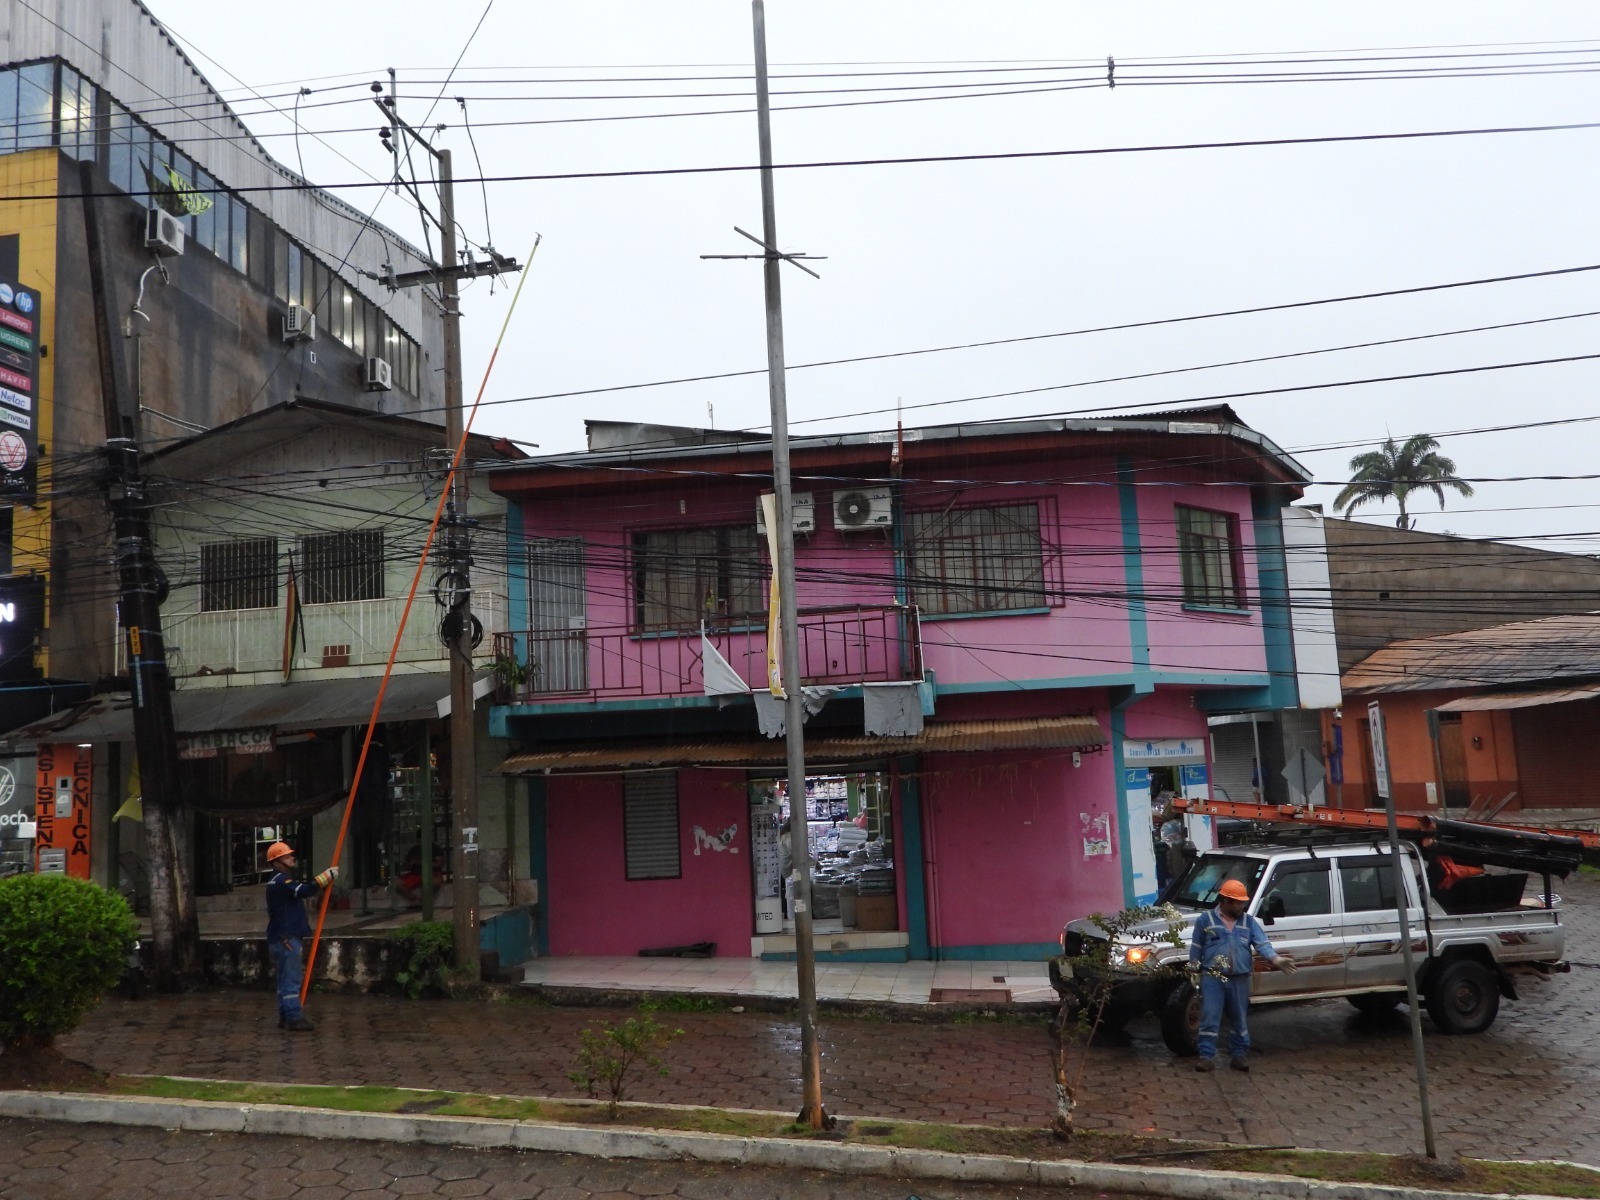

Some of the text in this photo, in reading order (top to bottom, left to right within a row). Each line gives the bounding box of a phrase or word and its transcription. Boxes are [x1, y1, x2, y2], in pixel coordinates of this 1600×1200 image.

[3, 312, 28, 329] Lenovo
[0, 332, 30, 349] UGREEN
[1, 371, 27, 387] HAVIT
[1, 390, 26, 407] Netac
